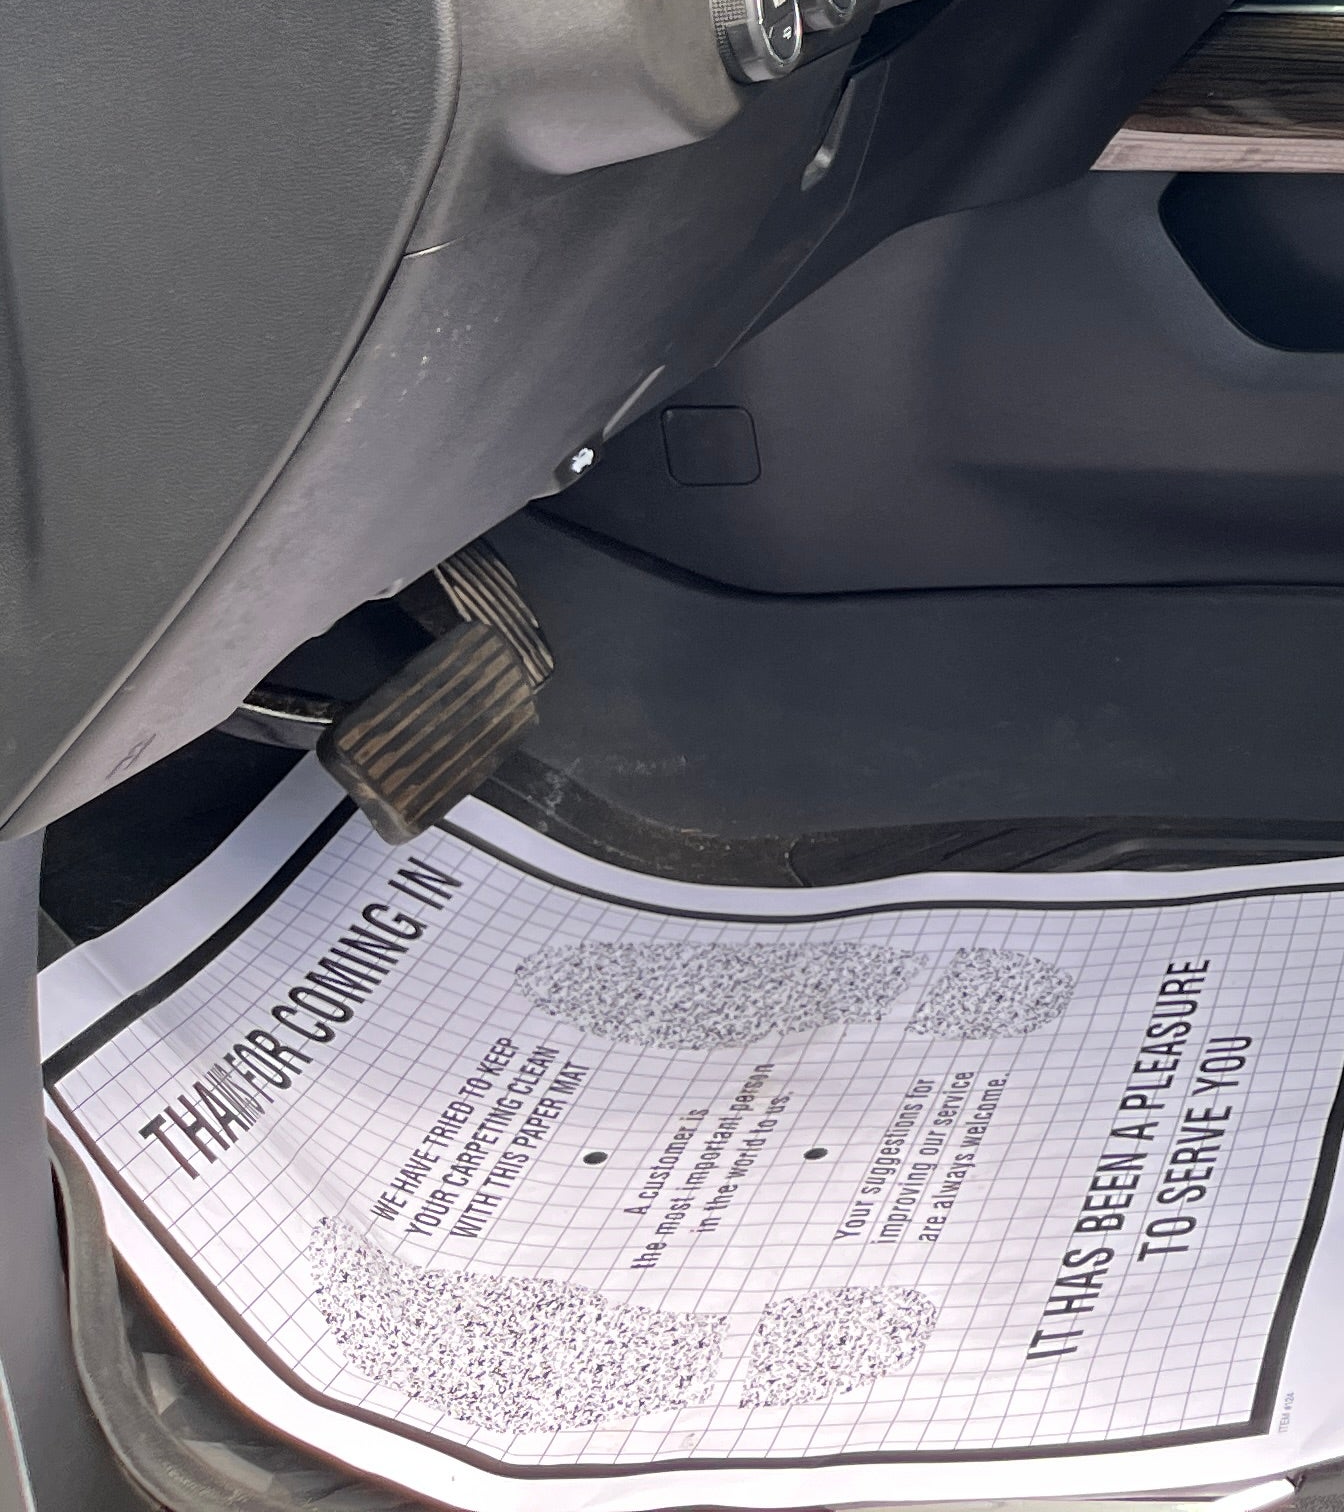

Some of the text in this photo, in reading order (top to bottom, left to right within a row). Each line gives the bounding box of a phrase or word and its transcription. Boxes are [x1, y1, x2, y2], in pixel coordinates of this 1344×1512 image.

[223, 1029, 314, 1104] FOR
[271, 903, 430, 1044] COMING
[387, 856, 464, 910] IN
[369, 1037, 519, 1222] WE HAVE TRIED TO KEEP
[405, 1045, 560, 1237] YOUR CARPETING CLEAN
[449, 1061, 590, 1239] WITH THIS PAPER MAT
[624, 1108, 709, 1215] A customer is
[630, 1063, 775, 1269] the most important person
[690, 1091, 794, 1233] in the world to us.
[833, 1078, 936, 1241] Your suggestions for
[870, 1071, 975, 1245] improving our service
[918, 1072, 1010, 1242] are always welcome.
[1026, 959, 1211, 1360] IT HAS BEEN A PLEASURE
[1137, 1035, 1254, 1262] TO SERVE YOU
